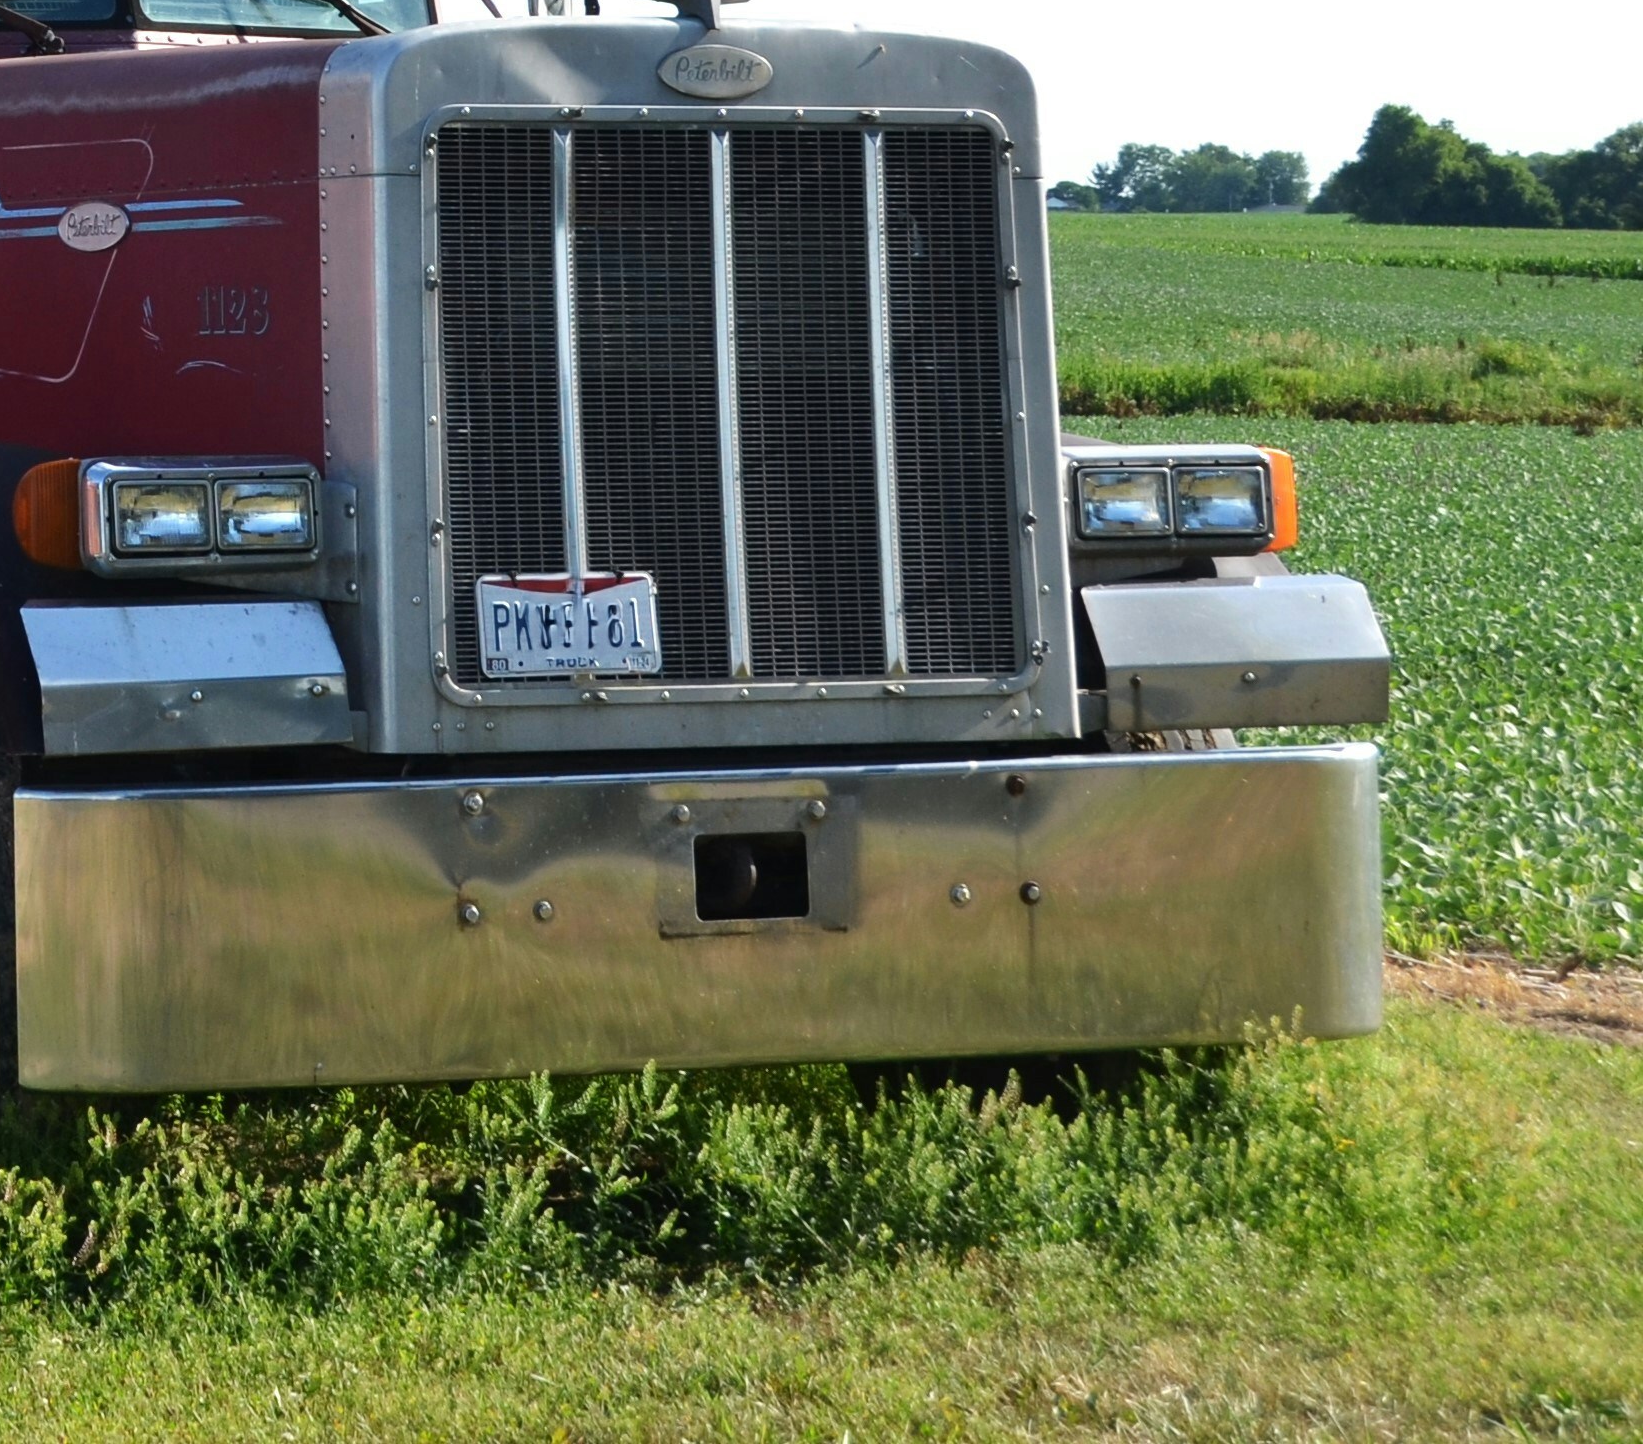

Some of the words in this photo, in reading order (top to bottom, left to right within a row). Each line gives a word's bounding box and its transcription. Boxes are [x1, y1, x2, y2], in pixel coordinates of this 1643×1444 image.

[676, 56, 762, 82] Peterbilt
[67, 212, 121, 241] Peterbilt
[196, 285, 270, 335] 1123
